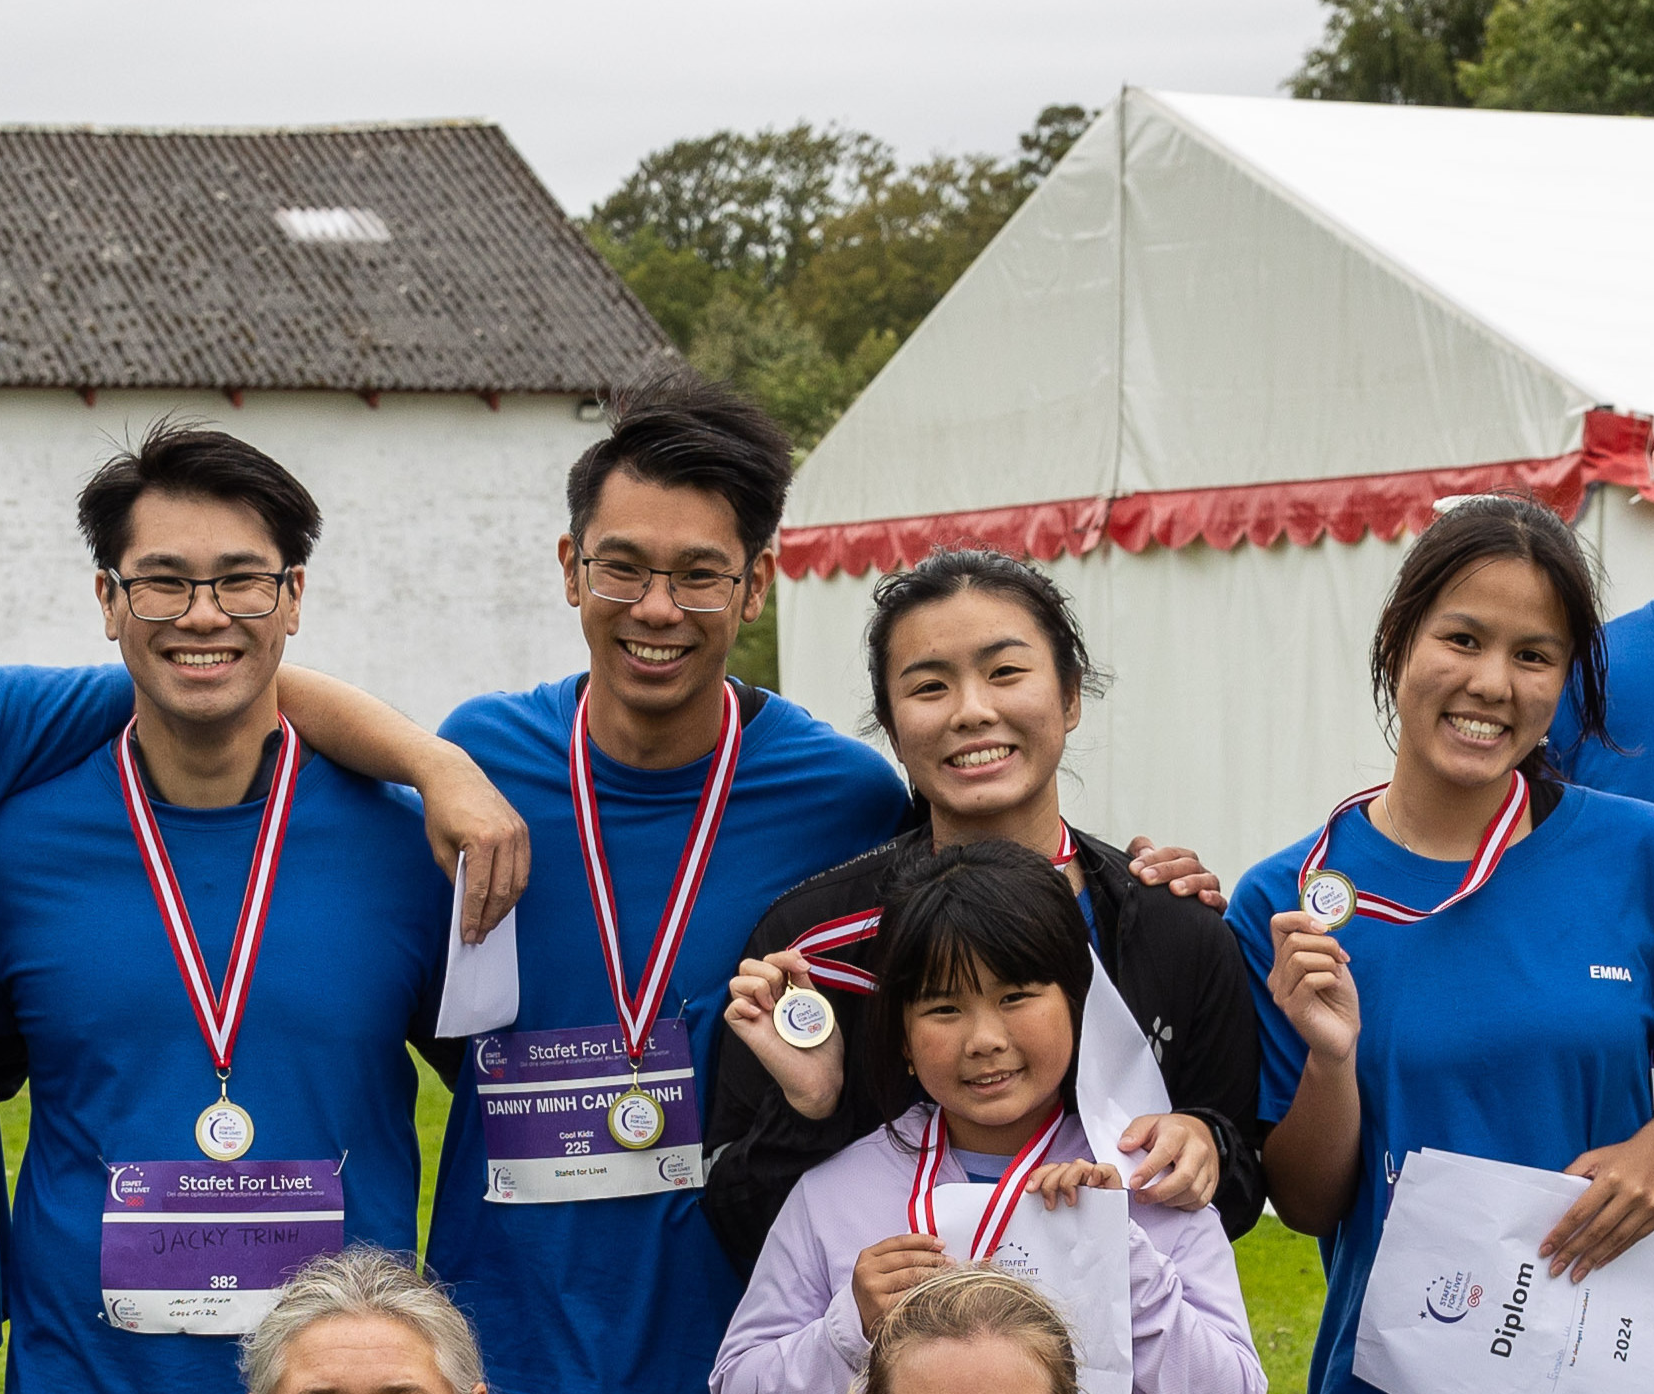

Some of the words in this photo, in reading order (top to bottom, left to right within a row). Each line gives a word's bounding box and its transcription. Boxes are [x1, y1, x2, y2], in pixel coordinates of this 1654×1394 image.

[1589, 964, 1632, 982] EMMA
[529, 1044, 576, 1060] Stafet
[582, 1041, 608, 1056] For
[612, 1037, 657, 1054] Liet
[487, 1099, 532, 1115] DANNY
[537, 1097, 578, 1113] MINH
[641, 1086, 683, 1103] INH
[559, 1131, 576, 1140] Cool
[578, 1130, 594, 1138] Kidz
[565, 1141, 591, 1155] 225
[554, 1169, 575, 1178] Stafet
[577, 1168, 588, 1176] for
[588, 1166, 608, 1175] Livet
[179, 1175, 234, 1191] Stafet
[239, 1176, 267, 1191] For
[271, 1175, 313, 1190] Livet
[149, 1227, 231, 1255] JACKY
[237, 1228, 300, 1246] TRINH
[999, 1259, 1027, 1267] STAFET
[210, 1275, 238, 1289] 382
[1447, 1294, 1457, 1309] FOR
[1453, 1271, 1464, 1293] LIVET
[1439, 1279, 1452, 1306] STAFET
[1490, 1262, 1534, 1358] Diplom
[1613, 1317, 1633, 1362] 2024
